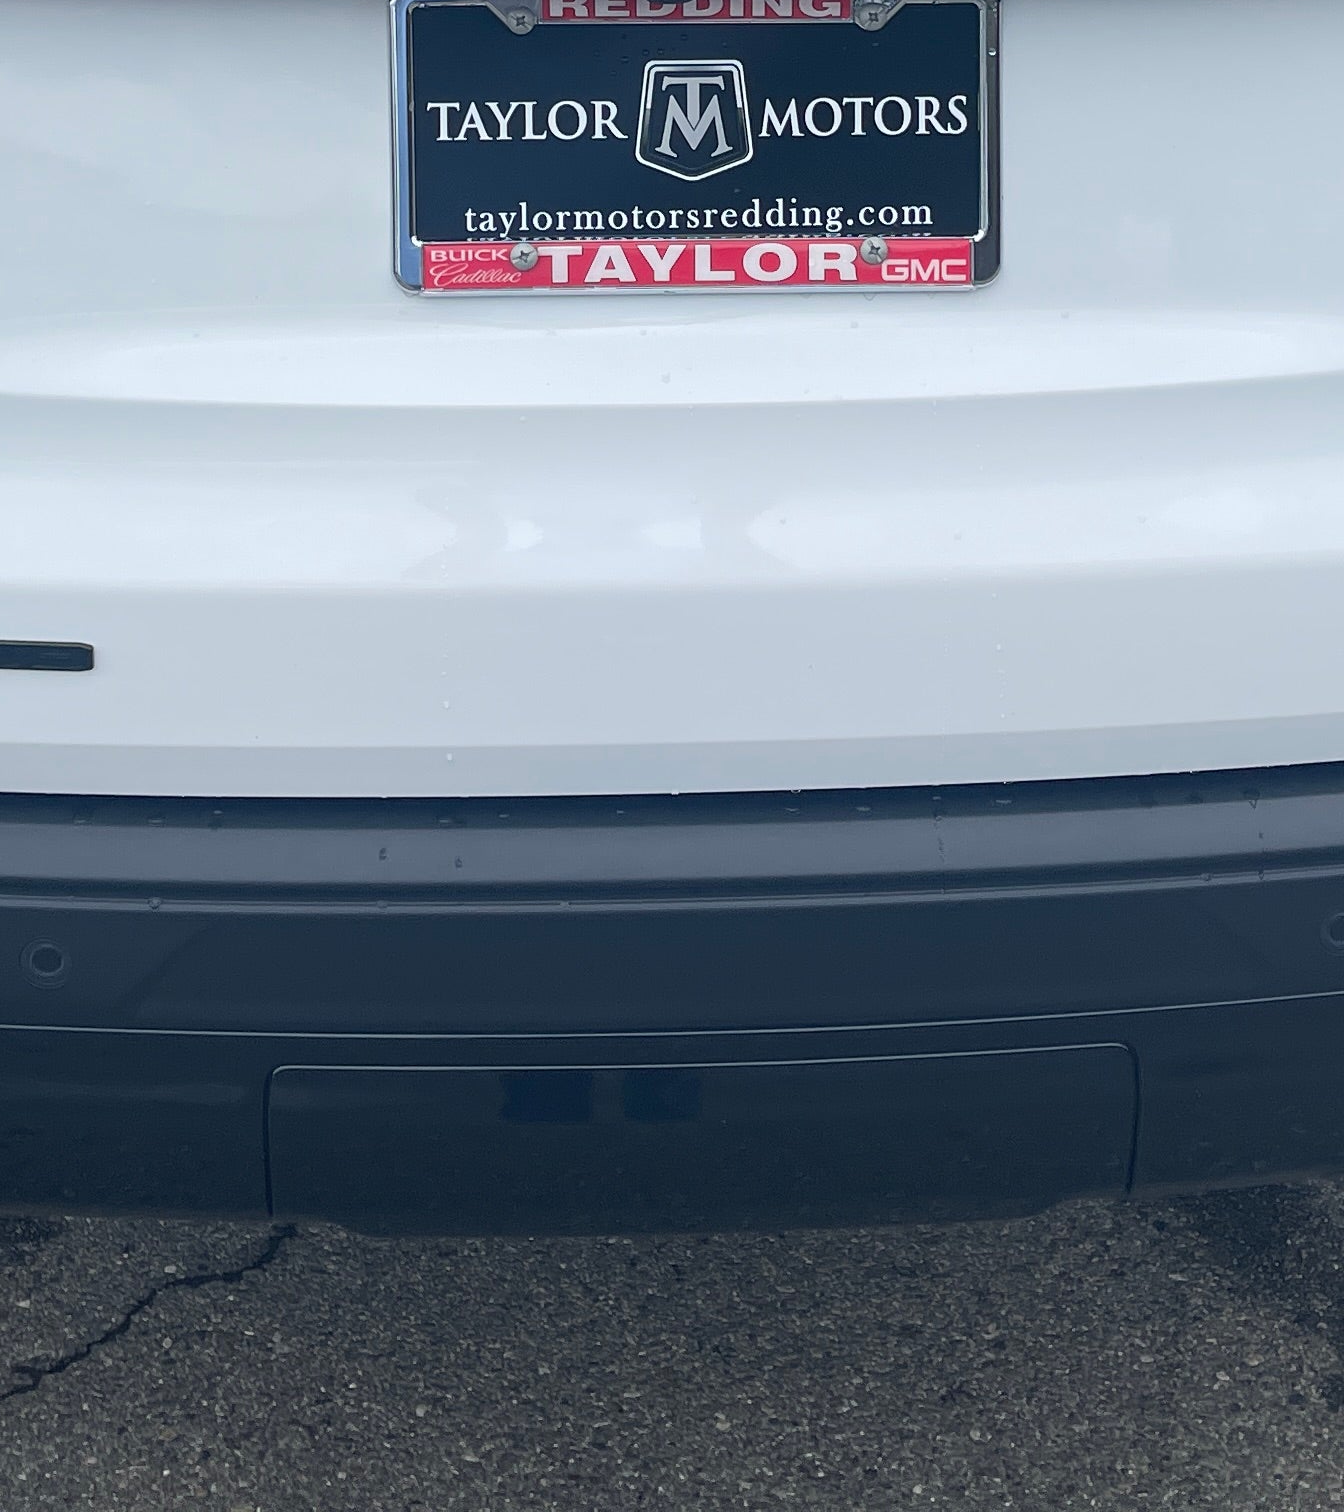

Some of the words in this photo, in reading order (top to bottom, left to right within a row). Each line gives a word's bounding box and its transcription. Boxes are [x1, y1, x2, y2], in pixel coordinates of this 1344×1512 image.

[427, 100, 628, 141] TAYLOR
[758, 95, 968, 137] MOTORS
[464, 198, 934, 238] taylormotorsredding.com
[430, 247, 510, 263] BUICK
[538, 242, 858, 284] TAYLOR
[880, 258, 968, 282] GMC
[429, 263, 522, 287] Cadillac
